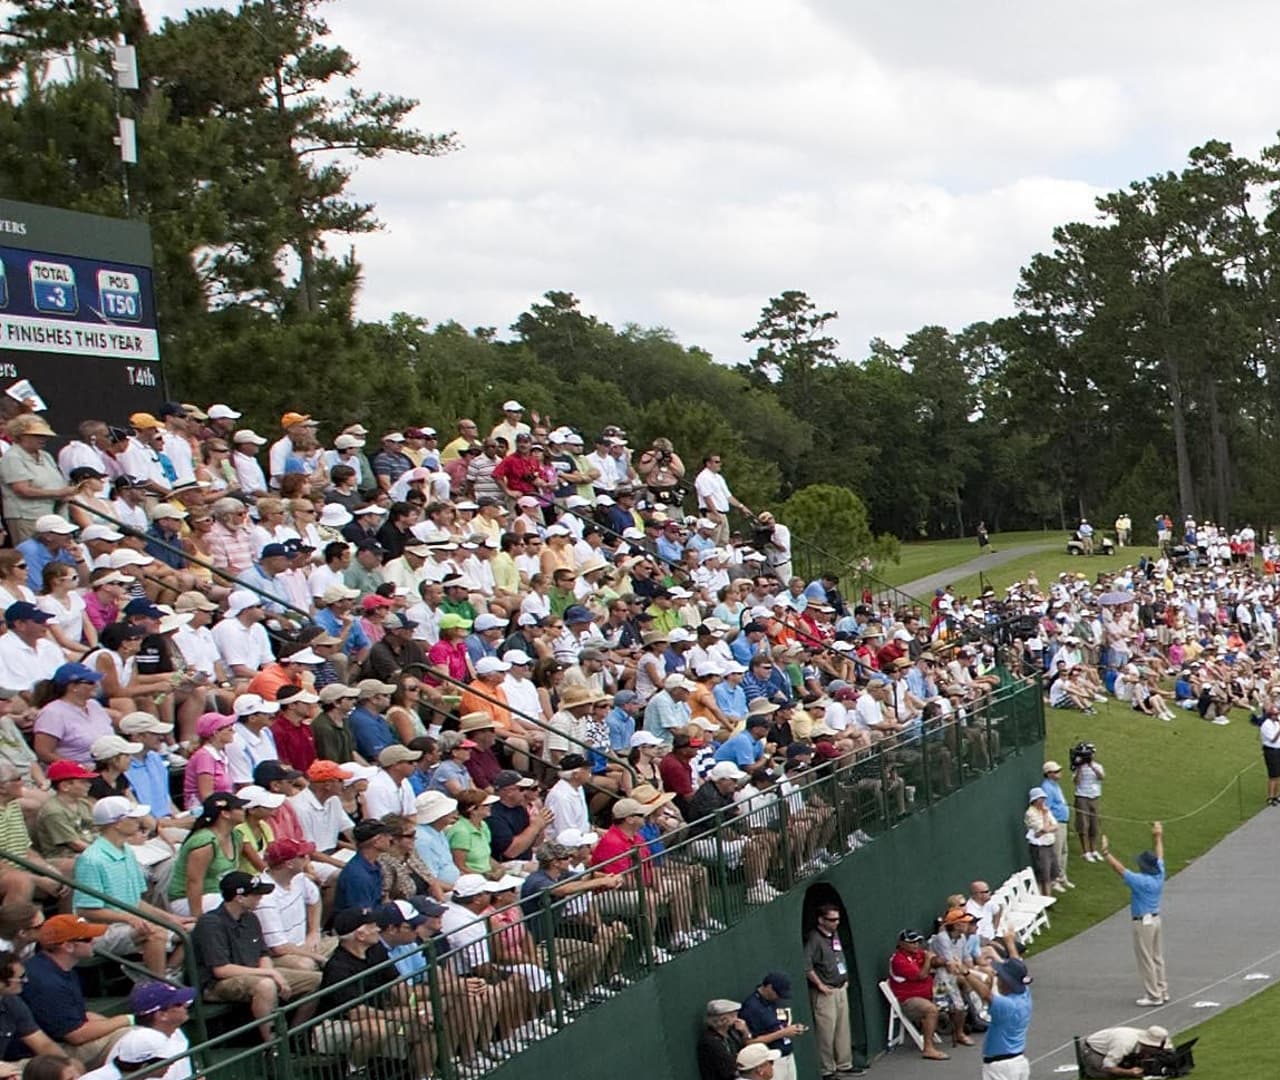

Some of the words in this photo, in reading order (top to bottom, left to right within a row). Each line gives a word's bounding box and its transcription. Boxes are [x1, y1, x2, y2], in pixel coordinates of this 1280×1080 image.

[35, 265, 69, 283] TOTAL
[109, 275, 129, 290] POS
[47, 287, 66, 308] -3
[106, 293, 136, 315] T50
[7, 324, 73, 345] FINISHES
[75, 330, 107, 349] THIS
[109, 333, 143, 352] YEAR
